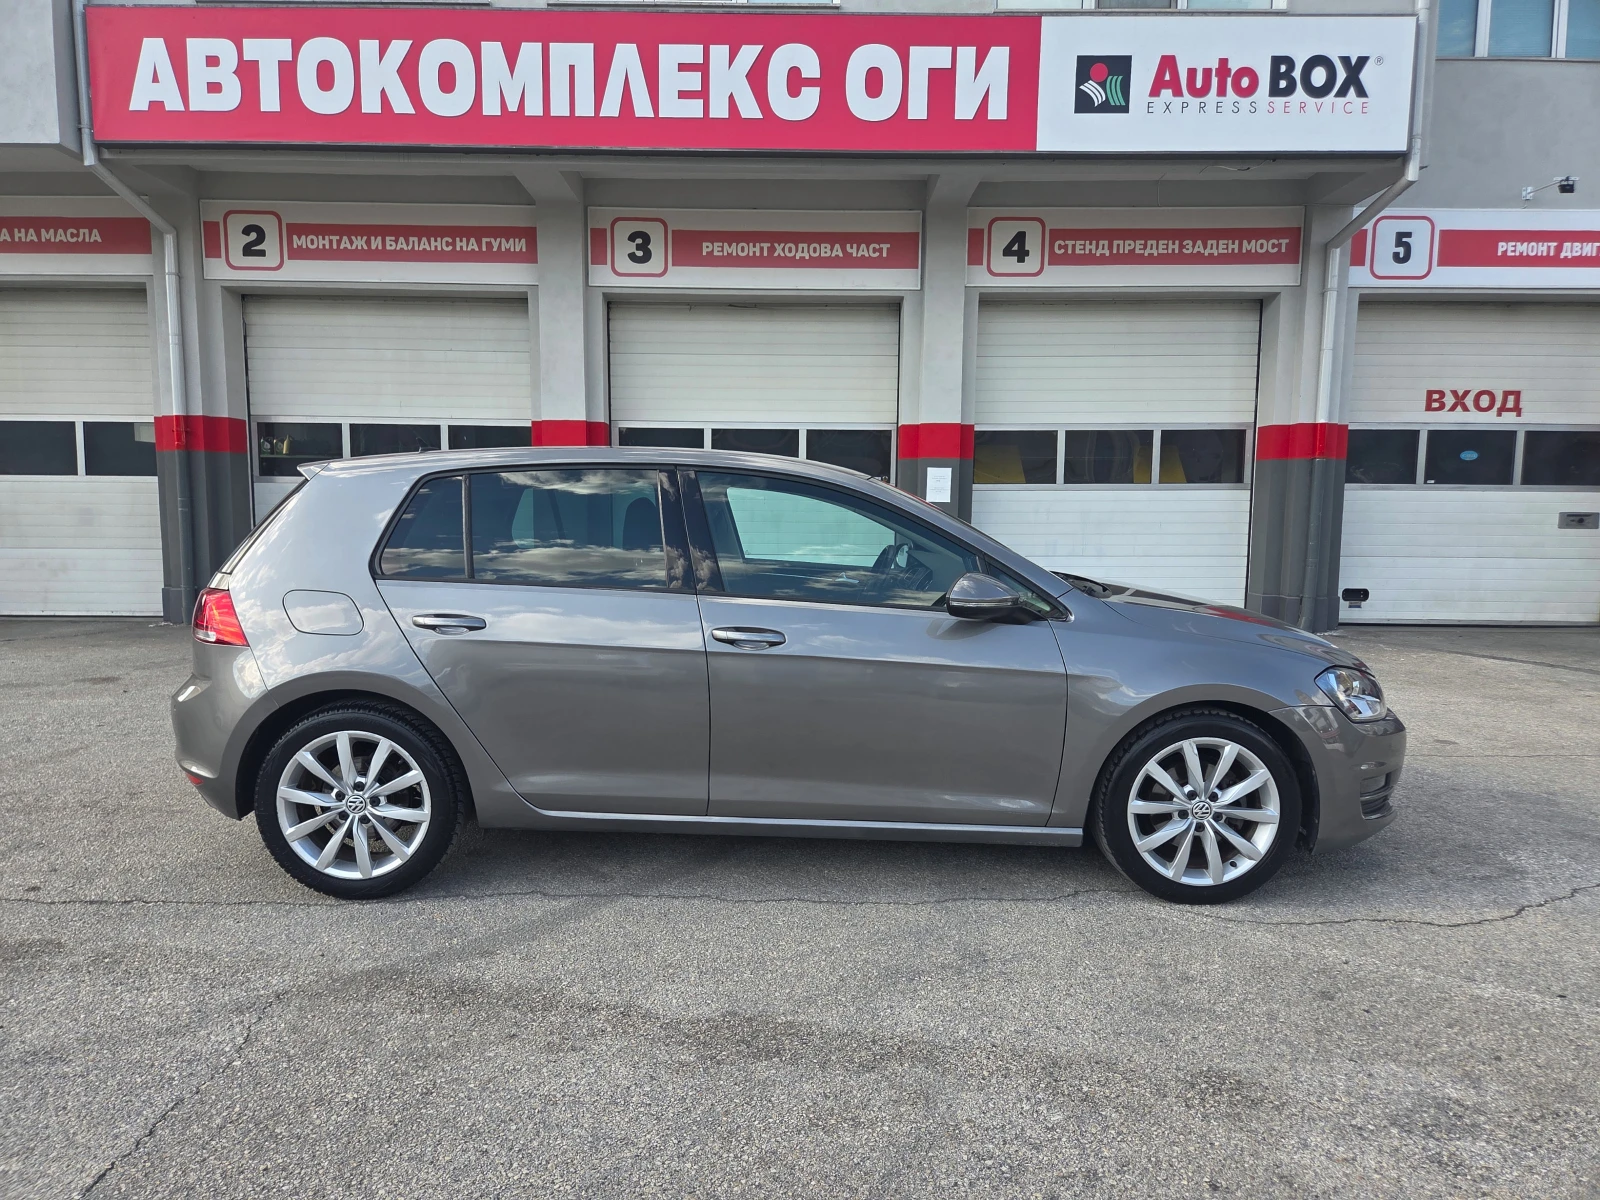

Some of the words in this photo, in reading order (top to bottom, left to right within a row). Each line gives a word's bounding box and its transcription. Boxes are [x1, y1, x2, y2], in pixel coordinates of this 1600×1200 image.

[128, 37, 821, 121] АВТОКОМПЛЕКС
[845, 43, 1010, 122] ОГИ
[1148, 54, 1260, 99] Auto
[1268, 54, 1371, 99] BOX
[13, 228, 39, 242] НА
[40, 228, 102, 243] МАСЛА
[240, 223, 267, 258] 2
[292, 234, 369, 250] МОНТАЖ
[370, 236, 383, 250] И
[385, 236, 453, 252] БАЛАНС
[455, 237, 480, 252] НА
[481, 237, 527, 252] ГУМИ
[626, 230, 653, 264] 3
[702, 241, 771, 257] РЕМОНТ
[773, 242, 844, 260] ХОДОВА
[846, 243, 891, 258] ЧАСТ
[1002, 230, 1030, 264] 4
[1054, 239, 1110, 257] СТЕНД
[1112, 239, 1180, 257] ПРЕДЕН
[1182, 239, 1239, 257] ЗАДЕН
[1241, 238, 1290, 254] МОСТ
[1392, 231, 1413, 265] 5
[1497, 241, 1559, 256] РЕМОНТ
[1559, 241, 1600, 259] ДВИГ
[1425, 389, 1522, 417] ВХОД
